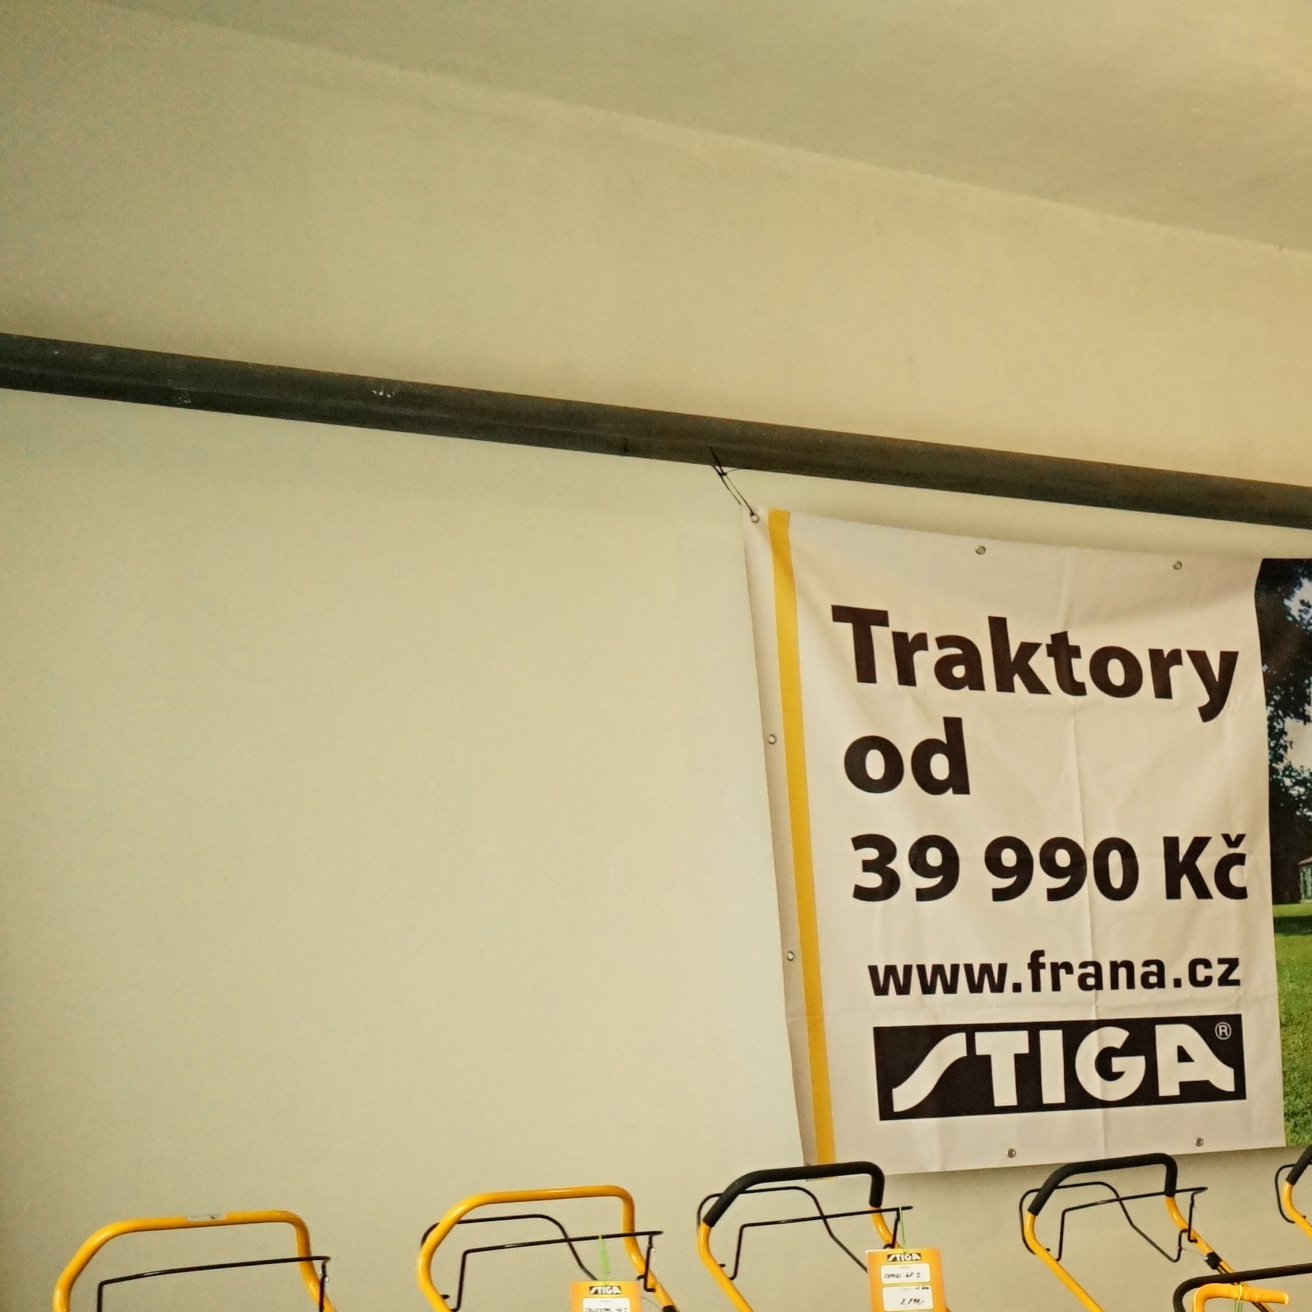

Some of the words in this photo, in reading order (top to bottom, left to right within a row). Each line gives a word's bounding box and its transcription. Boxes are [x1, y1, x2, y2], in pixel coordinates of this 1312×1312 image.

[832, 605, 1239, 723] Traktory
[843, 716, 972, 796] od
[851, 833, 960, 902] 39
[984, 836, 1140, 902] 990
[1164, 833, 1248, 901] Kč
[868, 949, 1241, 996] www.frana.cz
[887, 1253, 922, 1262] STIGA
[589, 1286, 622, 1295] STIGA
